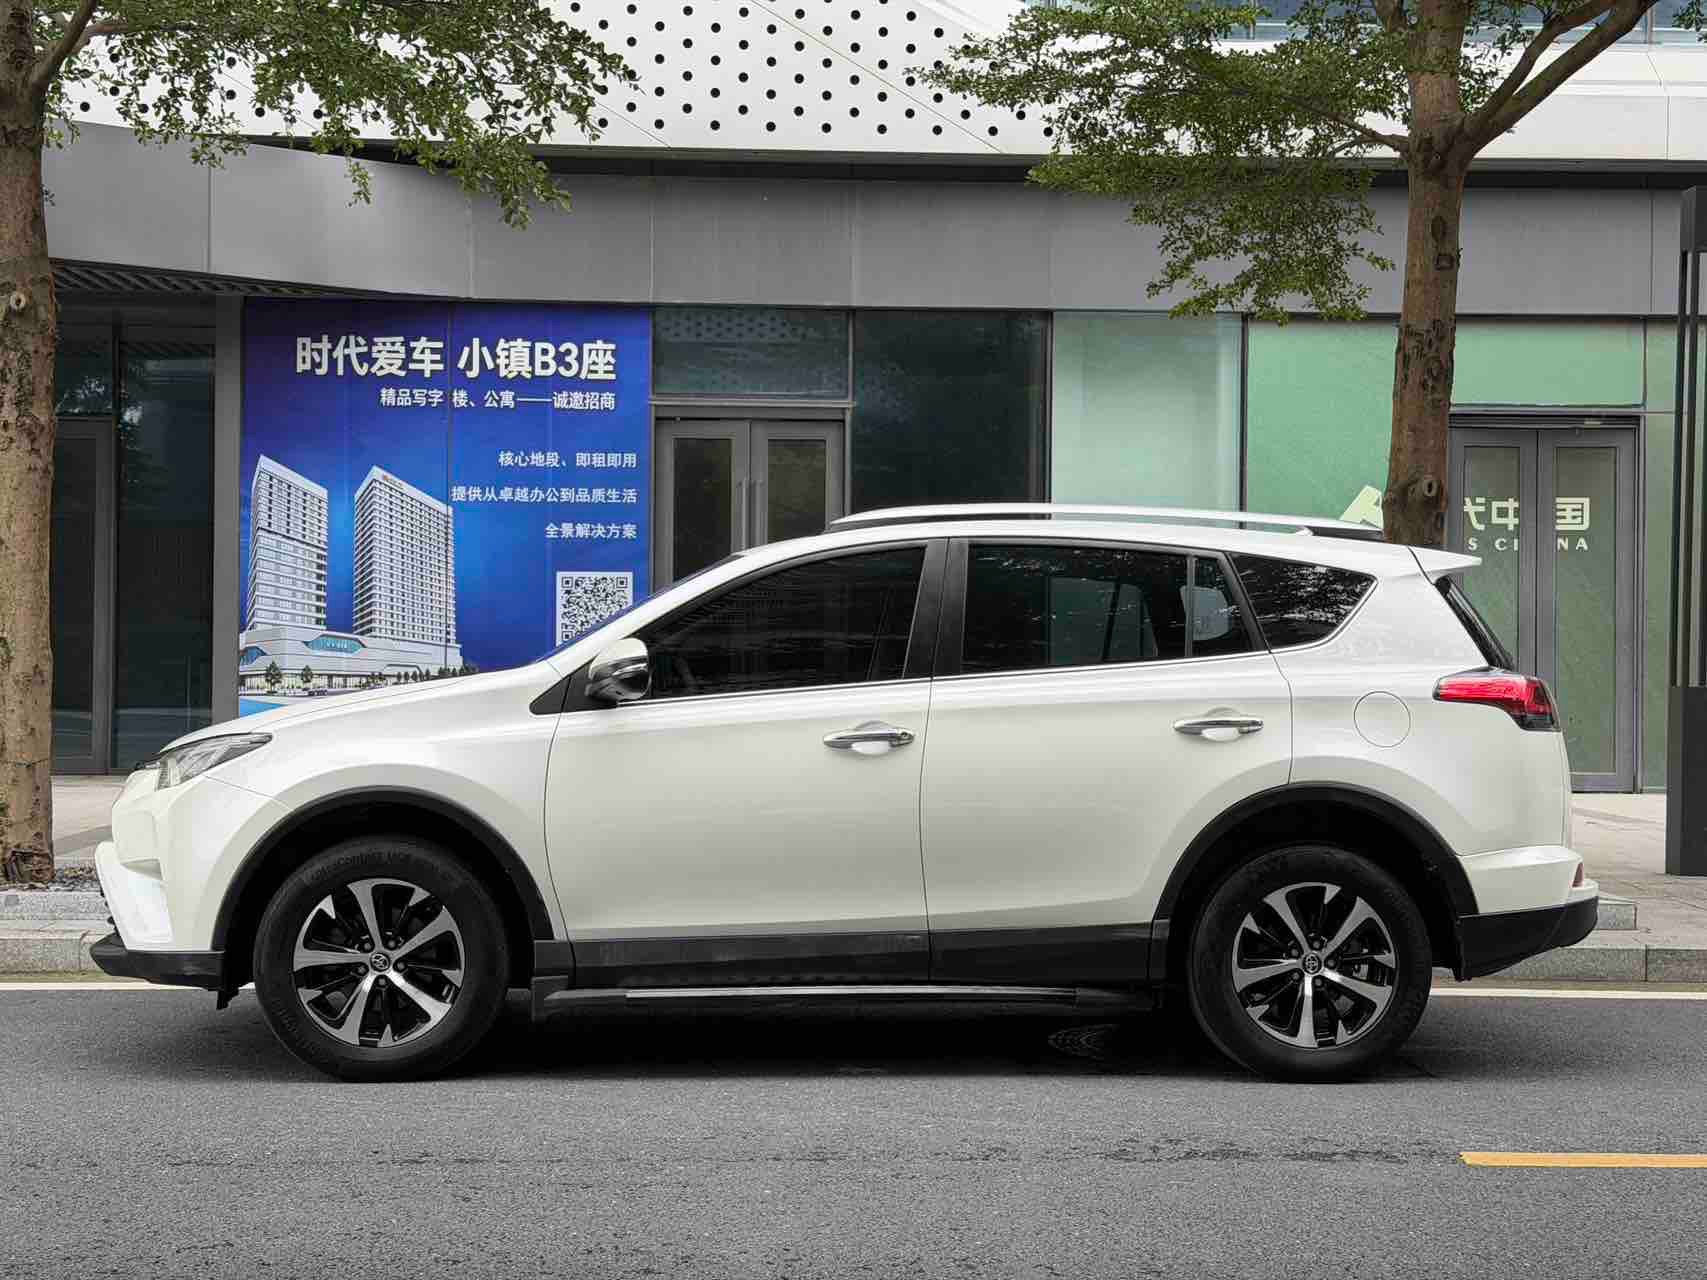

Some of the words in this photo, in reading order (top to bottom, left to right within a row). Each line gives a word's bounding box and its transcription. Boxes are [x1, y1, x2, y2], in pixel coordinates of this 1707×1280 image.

[450, 486, 638, 504] 提供从卓越办公到品质生活
[544, 522, 638, 539] 全景解决方案
